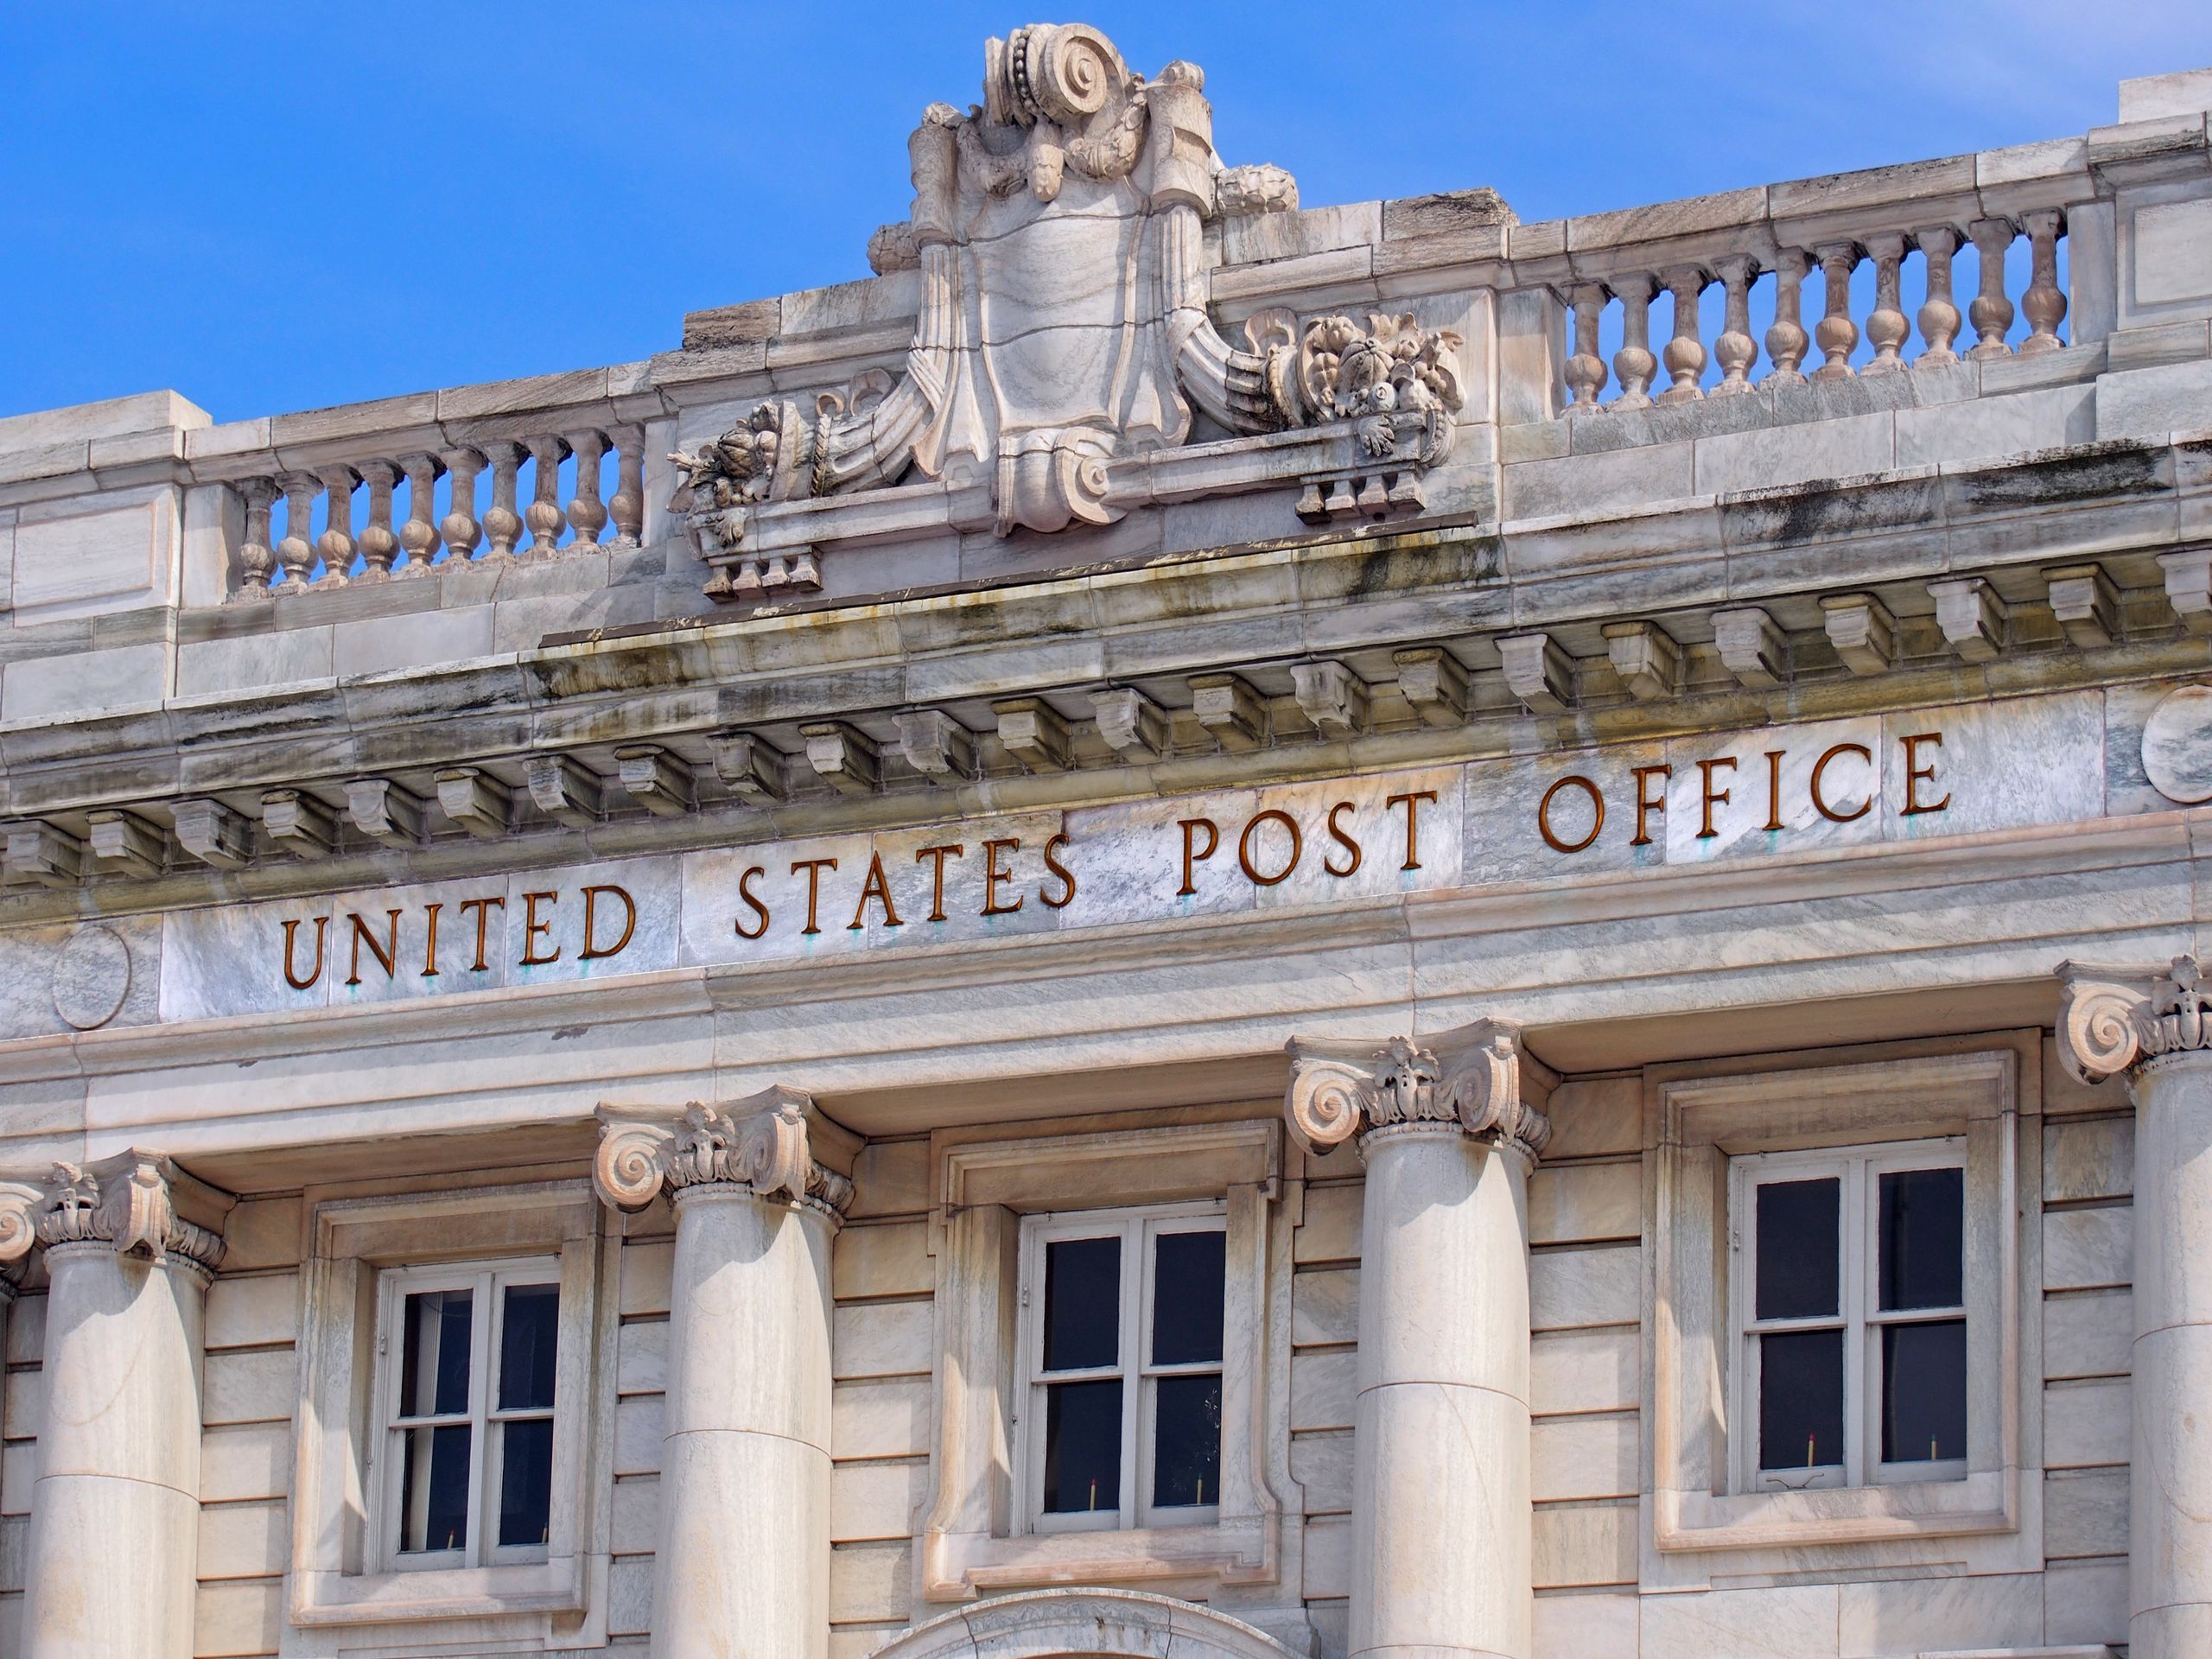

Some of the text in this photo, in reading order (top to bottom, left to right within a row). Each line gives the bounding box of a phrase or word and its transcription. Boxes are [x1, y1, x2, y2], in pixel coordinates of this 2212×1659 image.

[281, 732, 1951, 990] UNITED STATES POST OFFICE
